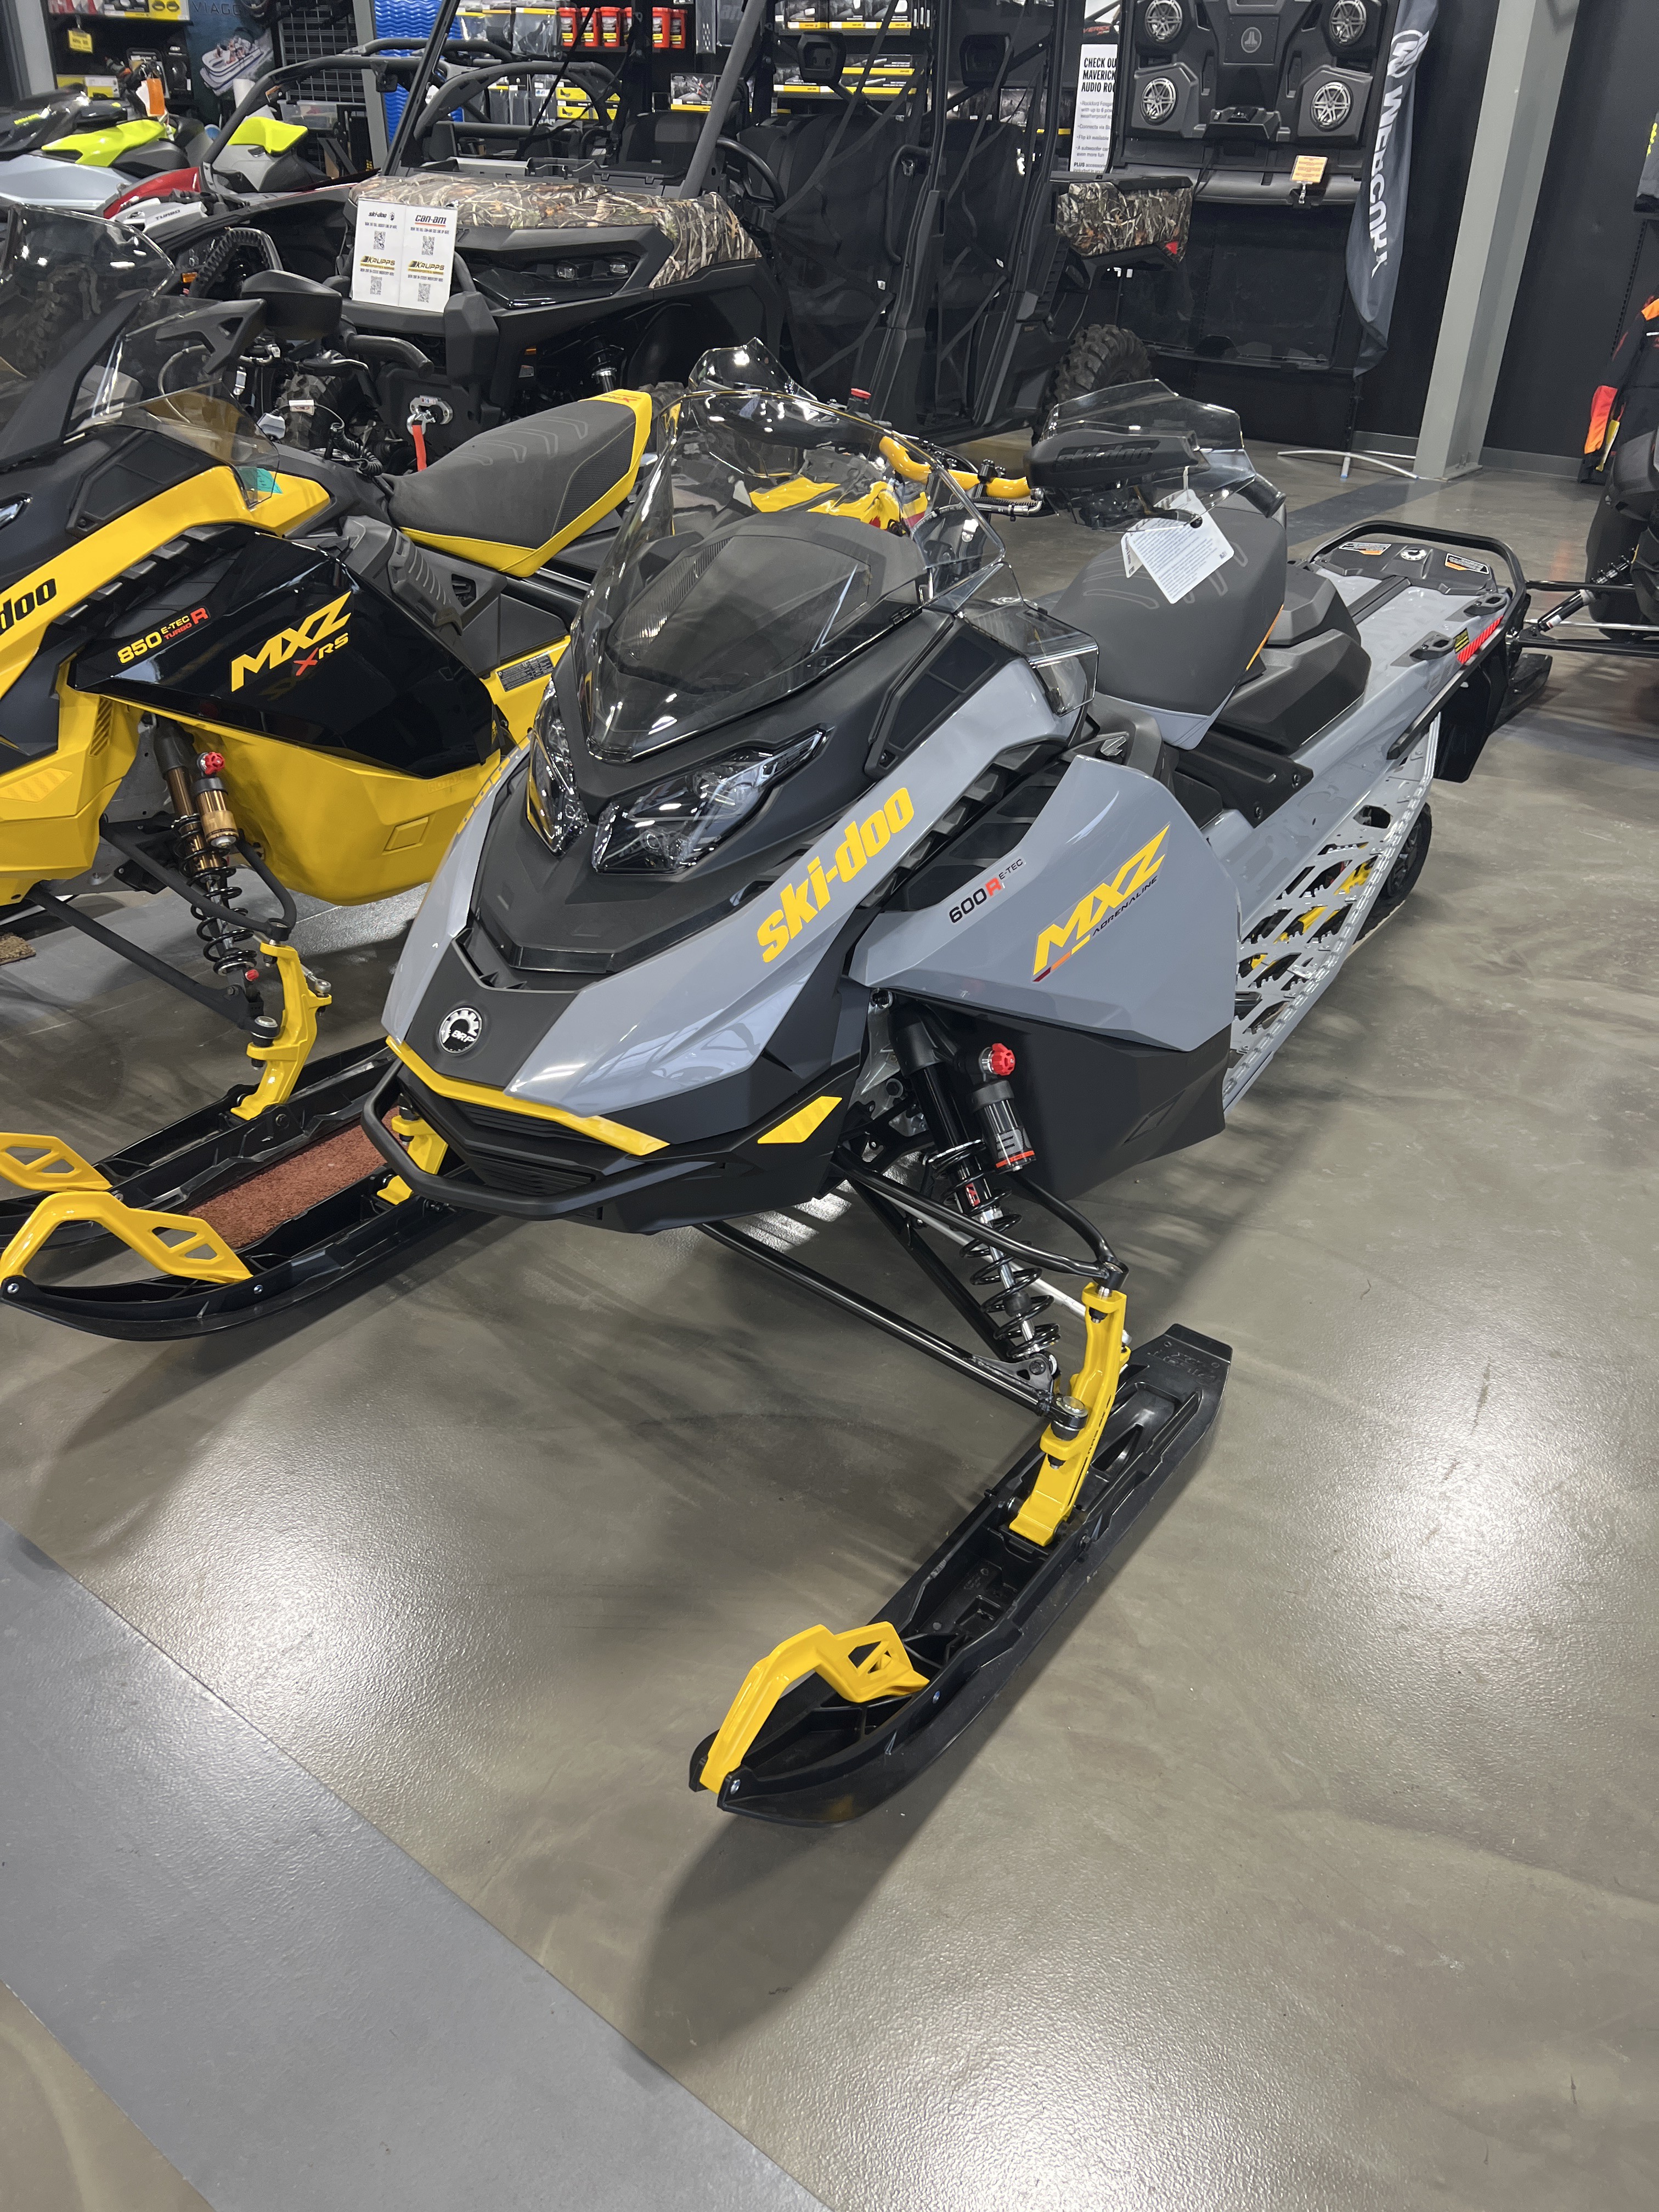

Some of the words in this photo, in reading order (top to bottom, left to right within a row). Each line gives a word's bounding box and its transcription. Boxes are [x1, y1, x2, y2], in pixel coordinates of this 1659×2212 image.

[192, 2, 242, 17] VIAGG
[1084, 57, 1106, 69] CHECK
[1107, 57, 1118, 69] OU
[1082, 69, 1116, 81] MAVERICK
[1081, 81, 1102, 93] AUDIO
[1103, 82, 1114, 93] RO
[415, 215, 447, 224] can-am
[367, 256, 395, 266] KRUPPS
[415, 261, 445, 270] KRUPPS
[117, 631, 162, 664] 850
[160, 615, 190, 635] E-TEC
[190, 607, 209, 624] R
[163, 622, 193, 640] TURBO
[231, 590, 352, 692] MXZ
[757, 787, 915, 963] ski-doo
[998, 858, 1023, 880] E-TEC
[1033, 823, 1171, 976] MXZ
[1092, 874, 1158, 937] ADRENALINE
[451, 1029, 476, 1042] BRP
